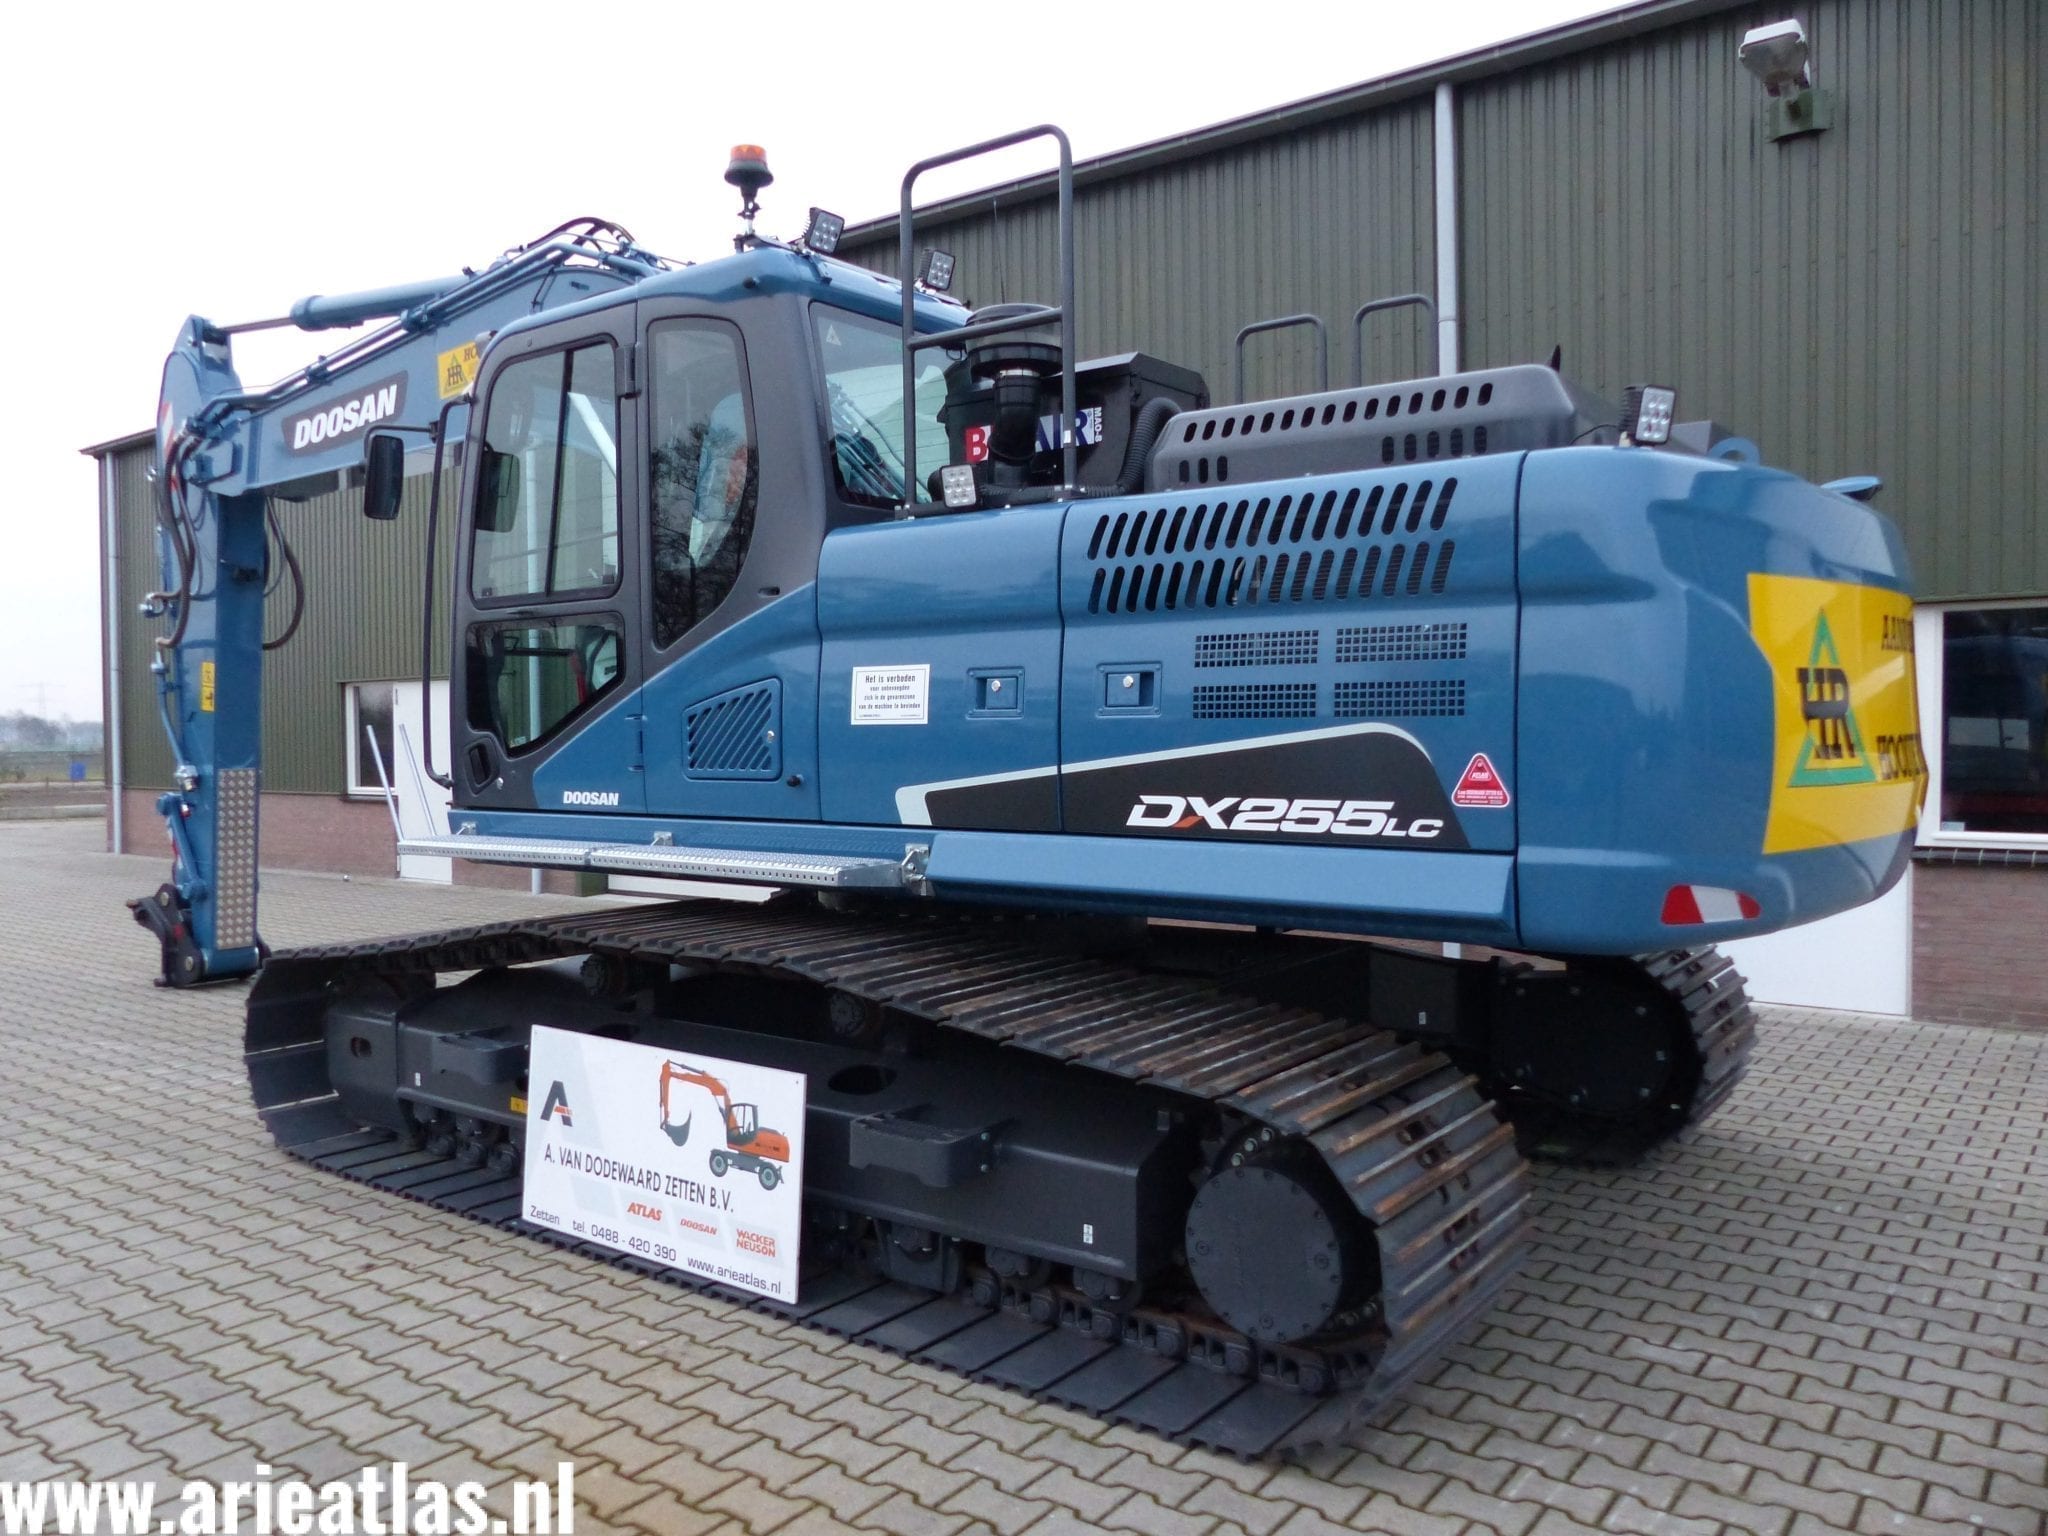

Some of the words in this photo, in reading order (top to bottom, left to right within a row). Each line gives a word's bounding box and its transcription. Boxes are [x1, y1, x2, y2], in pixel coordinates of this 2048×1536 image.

[293, 384, 398, 450] DOOSAN
[965, 408, 1089, 463] BAIR
[865, 674, 876, 684] Het
[878, 674, 884, 683] is
[886, 673, 916, 683] verboden
[563, 791, 619, 806] DOOSAN
[544, 1143, 556, 1164] A.
[559, 1146, 582, 1171] VAN
[585, 1153, 661, 1192] DODEWAARD
[665, 1174, 706, 1206] ZETTEN
[709, 1186, 735, 1213] B.V.
[627, 1202, 662, 1222] ATLAS
[680, 1218, 718, 1235] DOOSAN
[736, 1228, 775, 1248] WACKER
[736, 1238, 776, 1258] NEUSON
[530, 1205, 560, 1225] Zetten
[572, 1220, 587, 1234] tel.
[591, 1224, 619, 1244] 0488
[628, 1236, 651, 1254] 420
[654, 1243, 677, 1262] 390
[687, 1256, 782, 1294] www.arieatlas.nl
